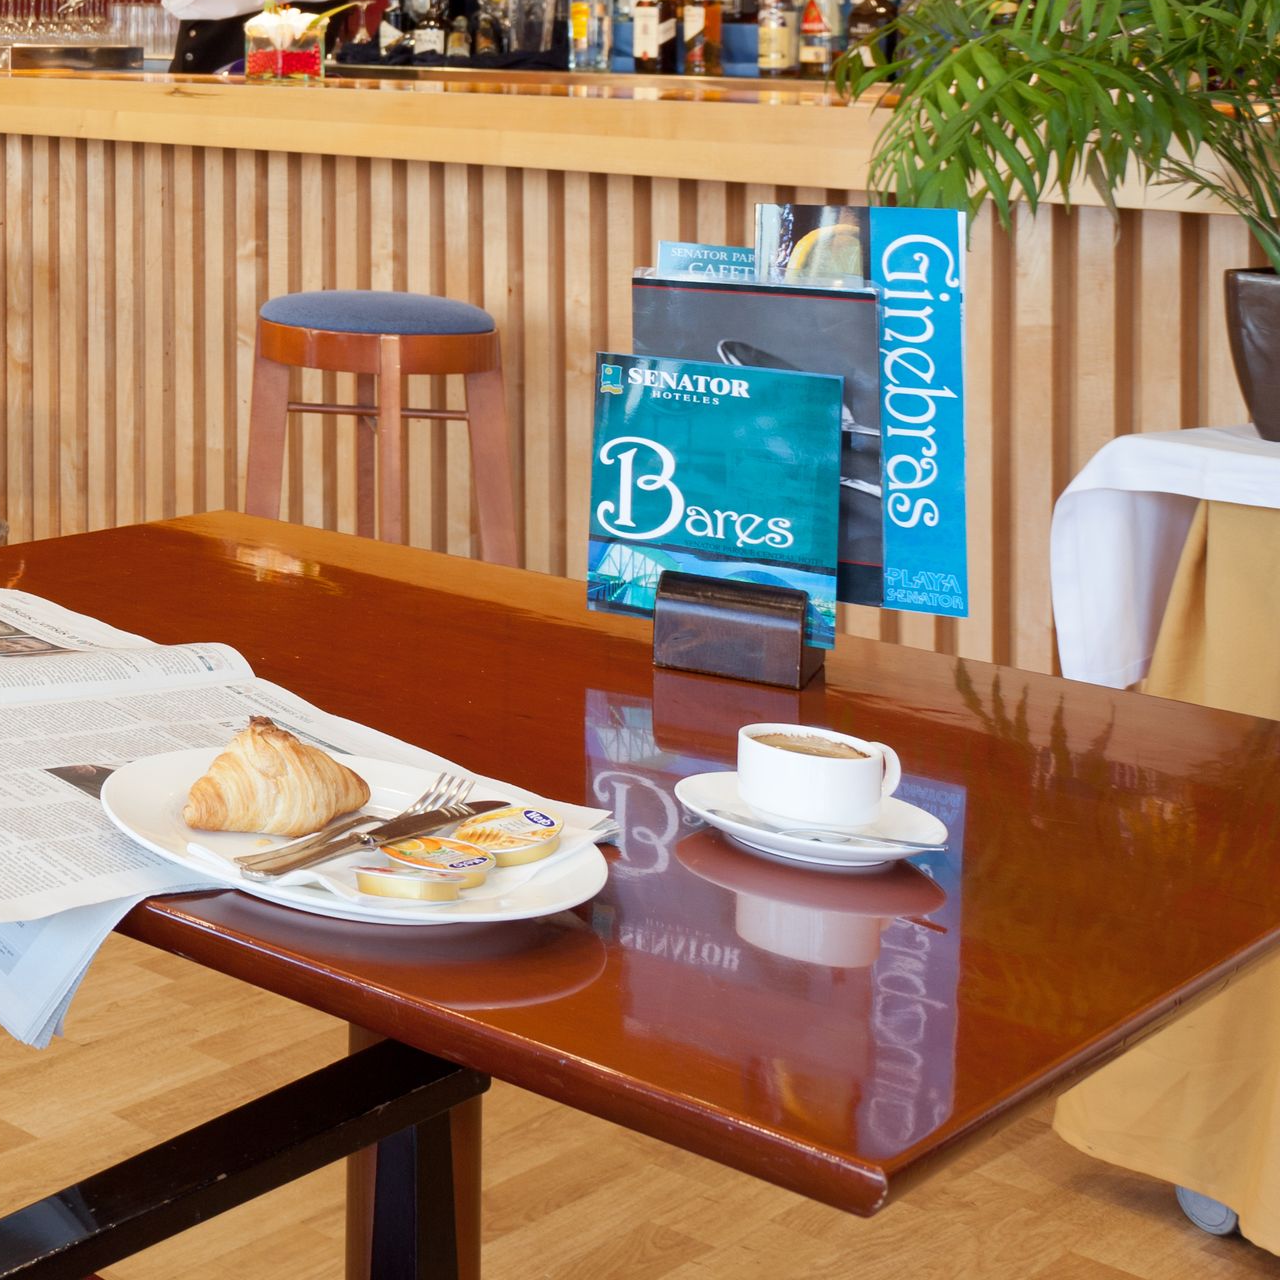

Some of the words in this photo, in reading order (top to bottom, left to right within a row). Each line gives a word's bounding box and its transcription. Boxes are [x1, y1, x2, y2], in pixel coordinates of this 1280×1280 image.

[670, 247, 728, 261] SENATOR
[627, 367, 751, 399] SENATOR
[881, 233, 961, 529] Ginebras
[651, 390, 720, 406] HOTELES
[596, 436, 795, 549] Bares
[884, 567, 962, 594] PLAYA
[886, 588, 964, 609] SENATOR
